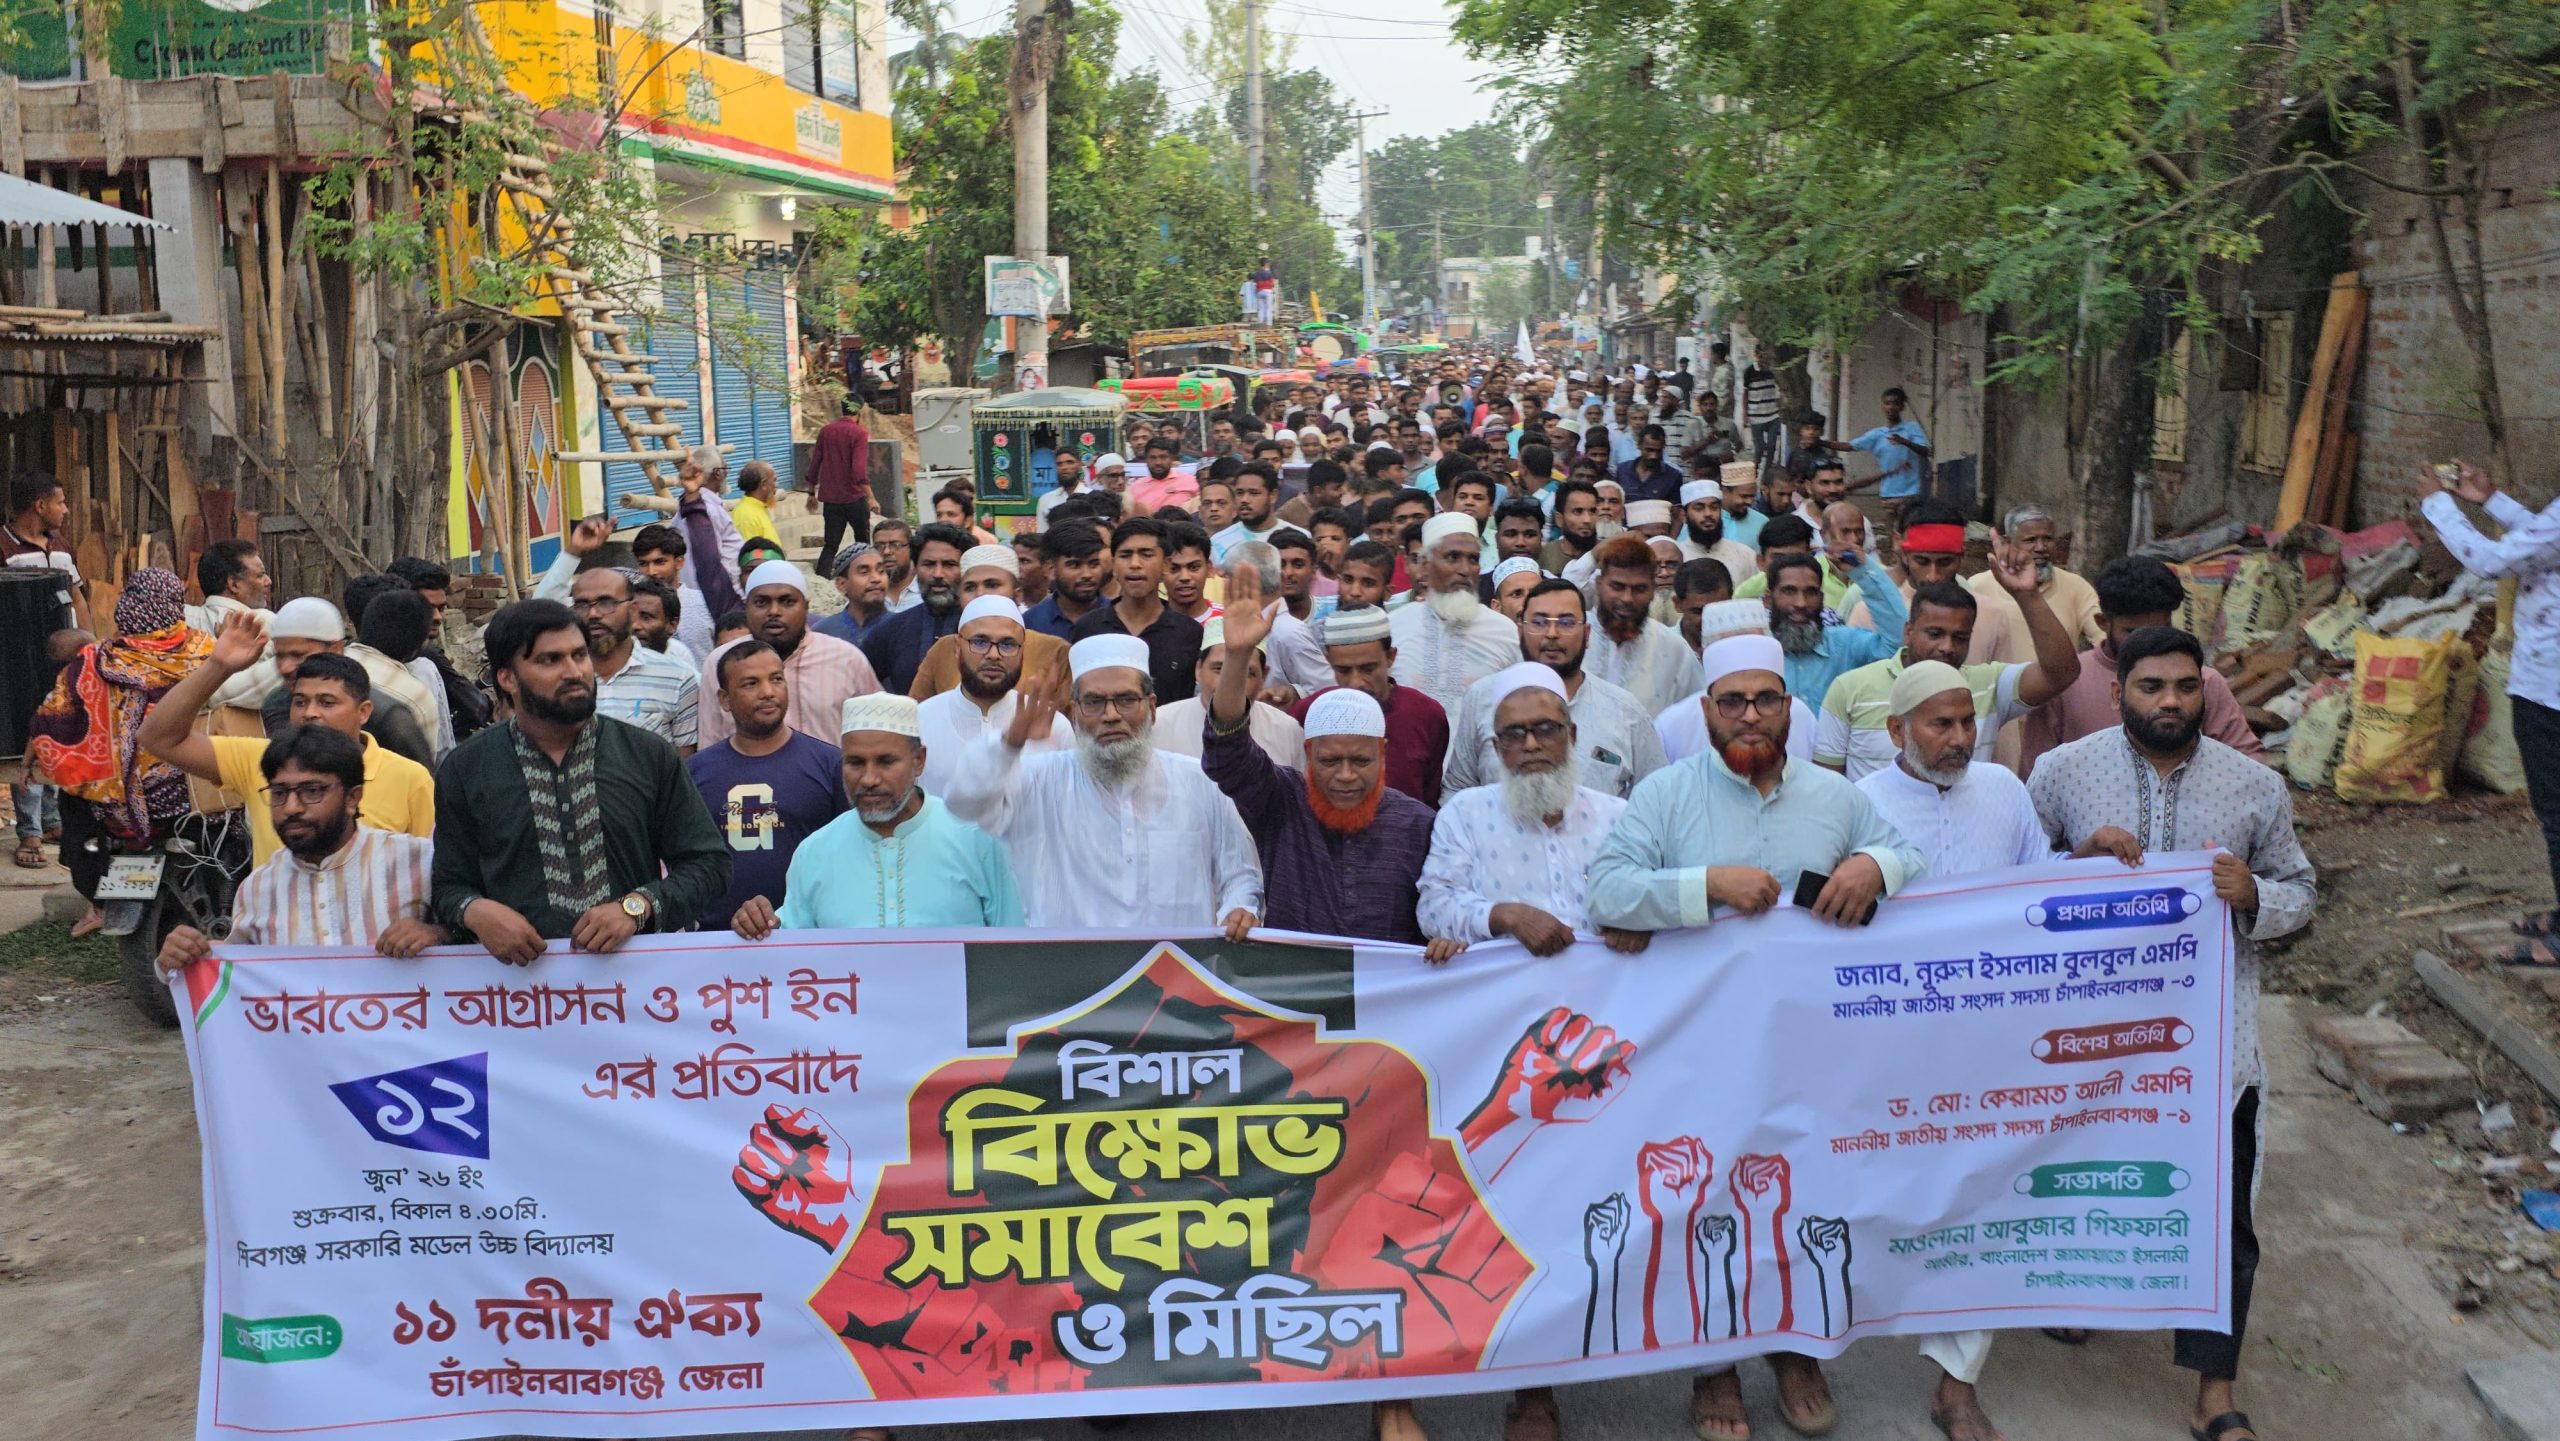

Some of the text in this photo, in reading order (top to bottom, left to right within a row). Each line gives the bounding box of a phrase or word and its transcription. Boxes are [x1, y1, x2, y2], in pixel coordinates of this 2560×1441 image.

[728, 783, 773, 851] G
[2056, 894, 2169, 923] প্রধান অতিথি
[1835, 934, 2198, 995] জনাব, নূরুল ইসলাম বুলবুল এমপি
[240, 969, 860, 1035] ভারতের আগ্রাসন ও পুশ ইন
[1833, 995, 1896, 1017] মাননীয়
[1902, 990, 1955, 1014] জাতীয়
[1961, 992, 2004, 1010] সংসদ
[2010, 989, 2050, 1005] সদস্য
[2056, 977, 2164, 1001] চাঁপাইনবাবগঞ্জ
[2058, 1024, 2165, 1053] বিশেষ অতিথি
[583, 1043, 862, 1100] এর প্রতিবাদে
[1057, 1039, 1244, 1100] বিশাল
[1888, 1098, 1917, 1117] ড.
[1981, 1085, 2068, 1109] কেরামত
[2076, 1070, 2124, 1099] আলী
[2131, 1066, 2192, 1093] এমপি
[376, 1076, 481, 1140] ১২
[1831, 1130, 1890, 1153] মাননীয়
[1896, 1123, 1947, 1145] জাতীয়
[1954, 1123, 1996, 1141] সংসদ
[2003, 1120, 2044, 1135] সদস্য
[2051, 1108, 2158, 1133] চাঁপাইনবাবগঞ্জ
[945, 1087, 1345, 1200] বিক্ষোভ
[418, 1171, 450, 1187] ২৬
[458, 1166, 484, 1189] ইং
[2055, 1165, 2144, 1189] সভাপতি
[293, 1205, 383, 1228] শুক্রবার,
[391, 1198, 451, 1220] বিকাল
[1889, 1209, 2190, 1254] মাওলানা আবুজার গিফফারী
[316, 1230, 401, 1260] সরকারি
[409, 1236, 471, 1255] মডেল
[479, 1231, 517, 1254] উচ্চ
[524, 1230, 614, 1256] বিদ্যালয়
[887, 1197, 1274, 1292] সমাবেশ
[1980, 1250, 2047, 1264] বাংলাদেশ
[2133, 1245, 2188, 1264] ইসলামী
[394, 1277, 762, 1347] ১১ দলীয় ঐক্য
[1058, 1273, 1401, 1364] ও মিছিল
[430, 1357, 764, 1400] চাঁপাইনবাবগঞ্জ জেলা
